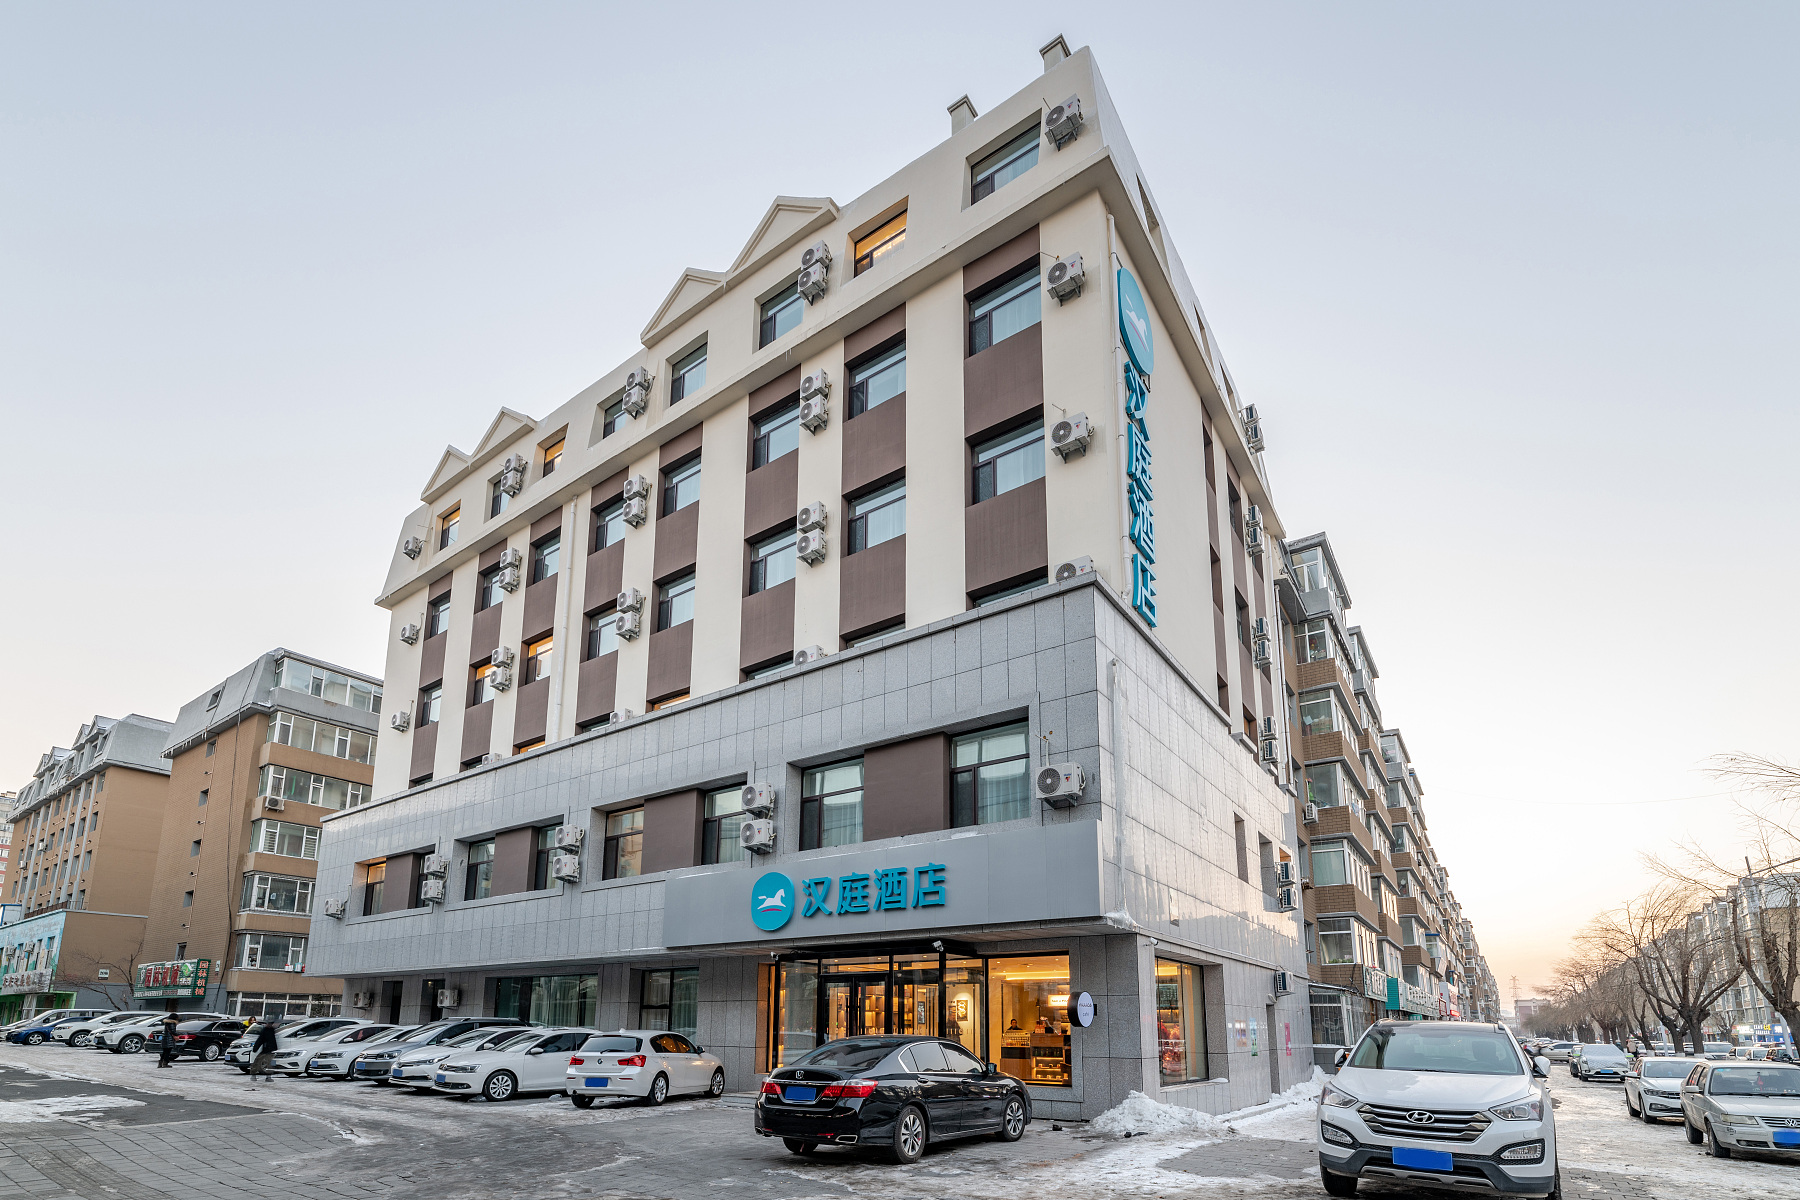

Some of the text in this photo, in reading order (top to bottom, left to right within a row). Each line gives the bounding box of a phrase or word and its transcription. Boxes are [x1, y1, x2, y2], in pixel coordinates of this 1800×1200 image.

[1124, 360, 1158, 628] 汉庭酒店
[801, 862, 946, 917] 汉庭酒店
[144, 964, 180, 987] 园林机械
[194, 960, 209, 996] 园林机械
